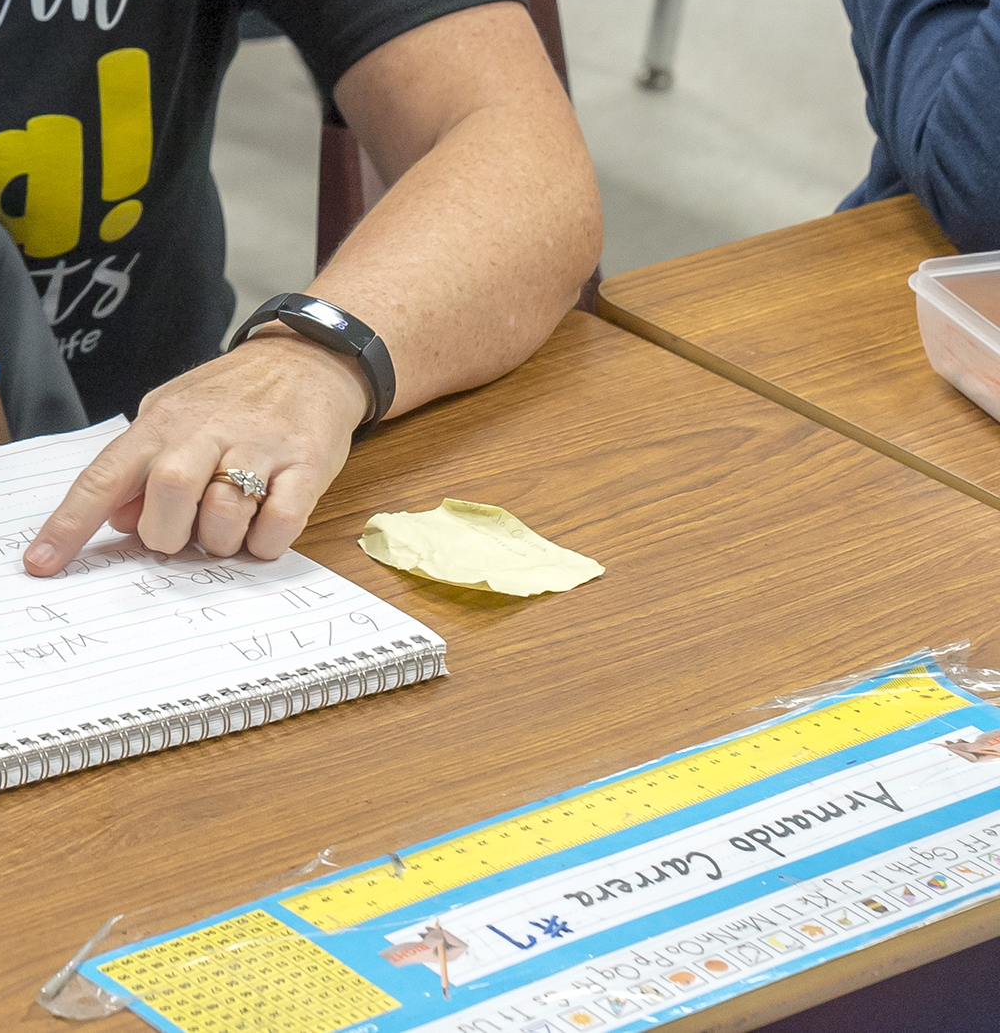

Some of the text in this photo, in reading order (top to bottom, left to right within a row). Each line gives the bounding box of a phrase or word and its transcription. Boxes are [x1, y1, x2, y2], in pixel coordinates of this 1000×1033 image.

[485, 781, 903, 950] Armando Carrera #7
